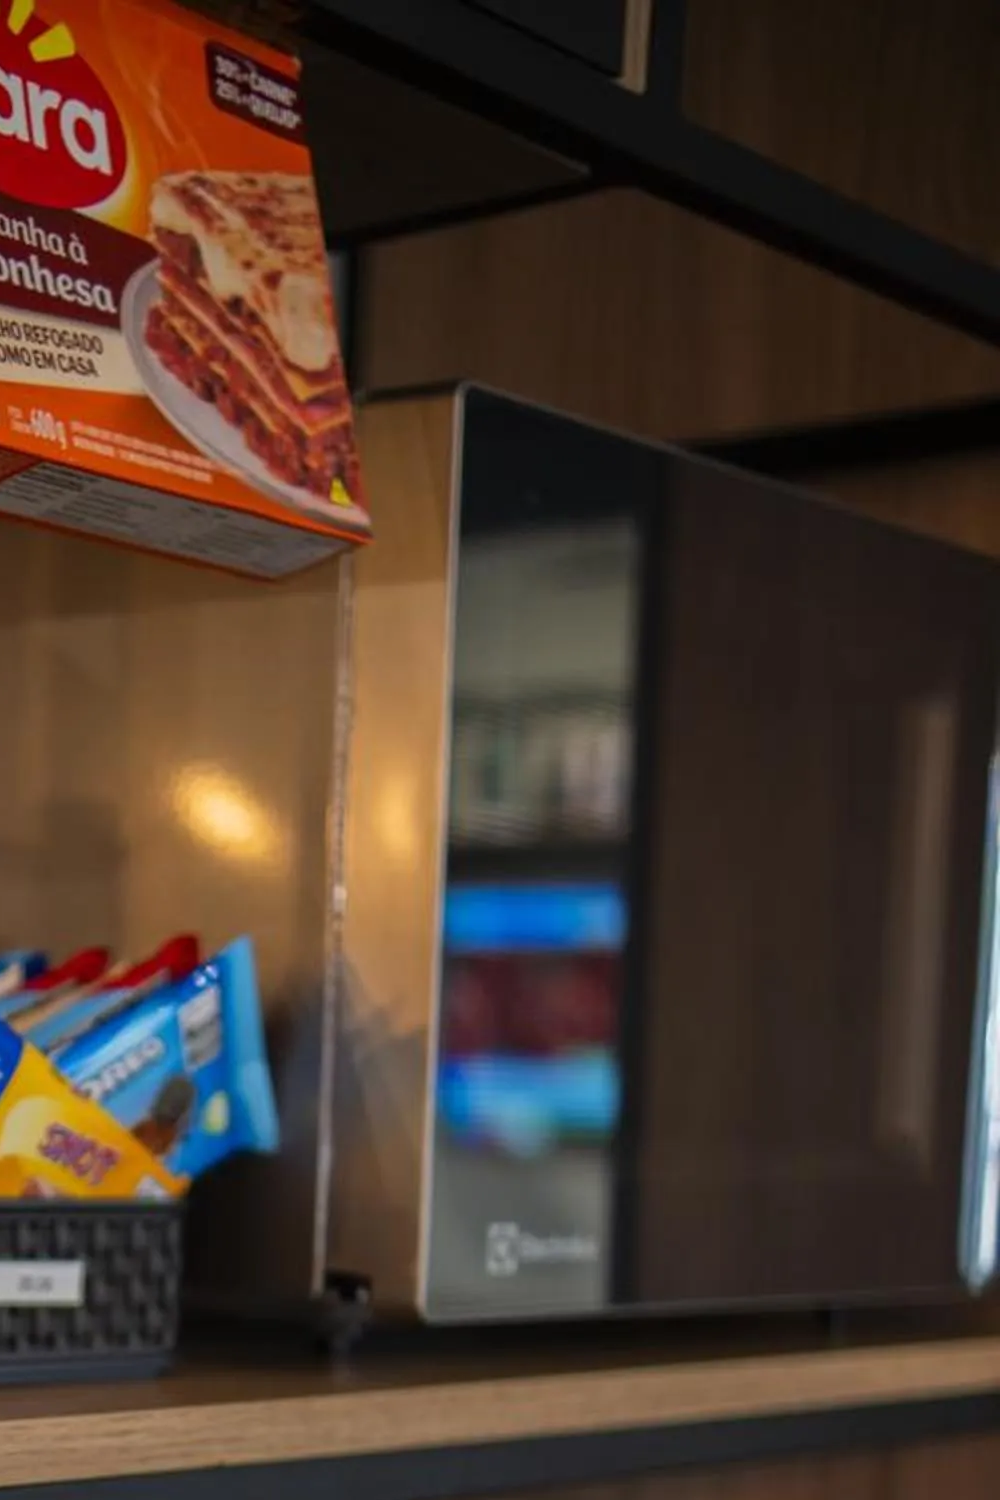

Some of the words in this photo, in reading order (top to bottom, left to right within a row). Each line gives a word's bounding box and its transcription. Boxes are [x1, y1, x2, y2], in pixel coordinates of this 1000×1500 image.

[68, 233, 89, 266] à
[23, 325, 104, 355] REFOGADO
[34, 349, 55, 371] EM
[57, 352, 99, 378] CASA
